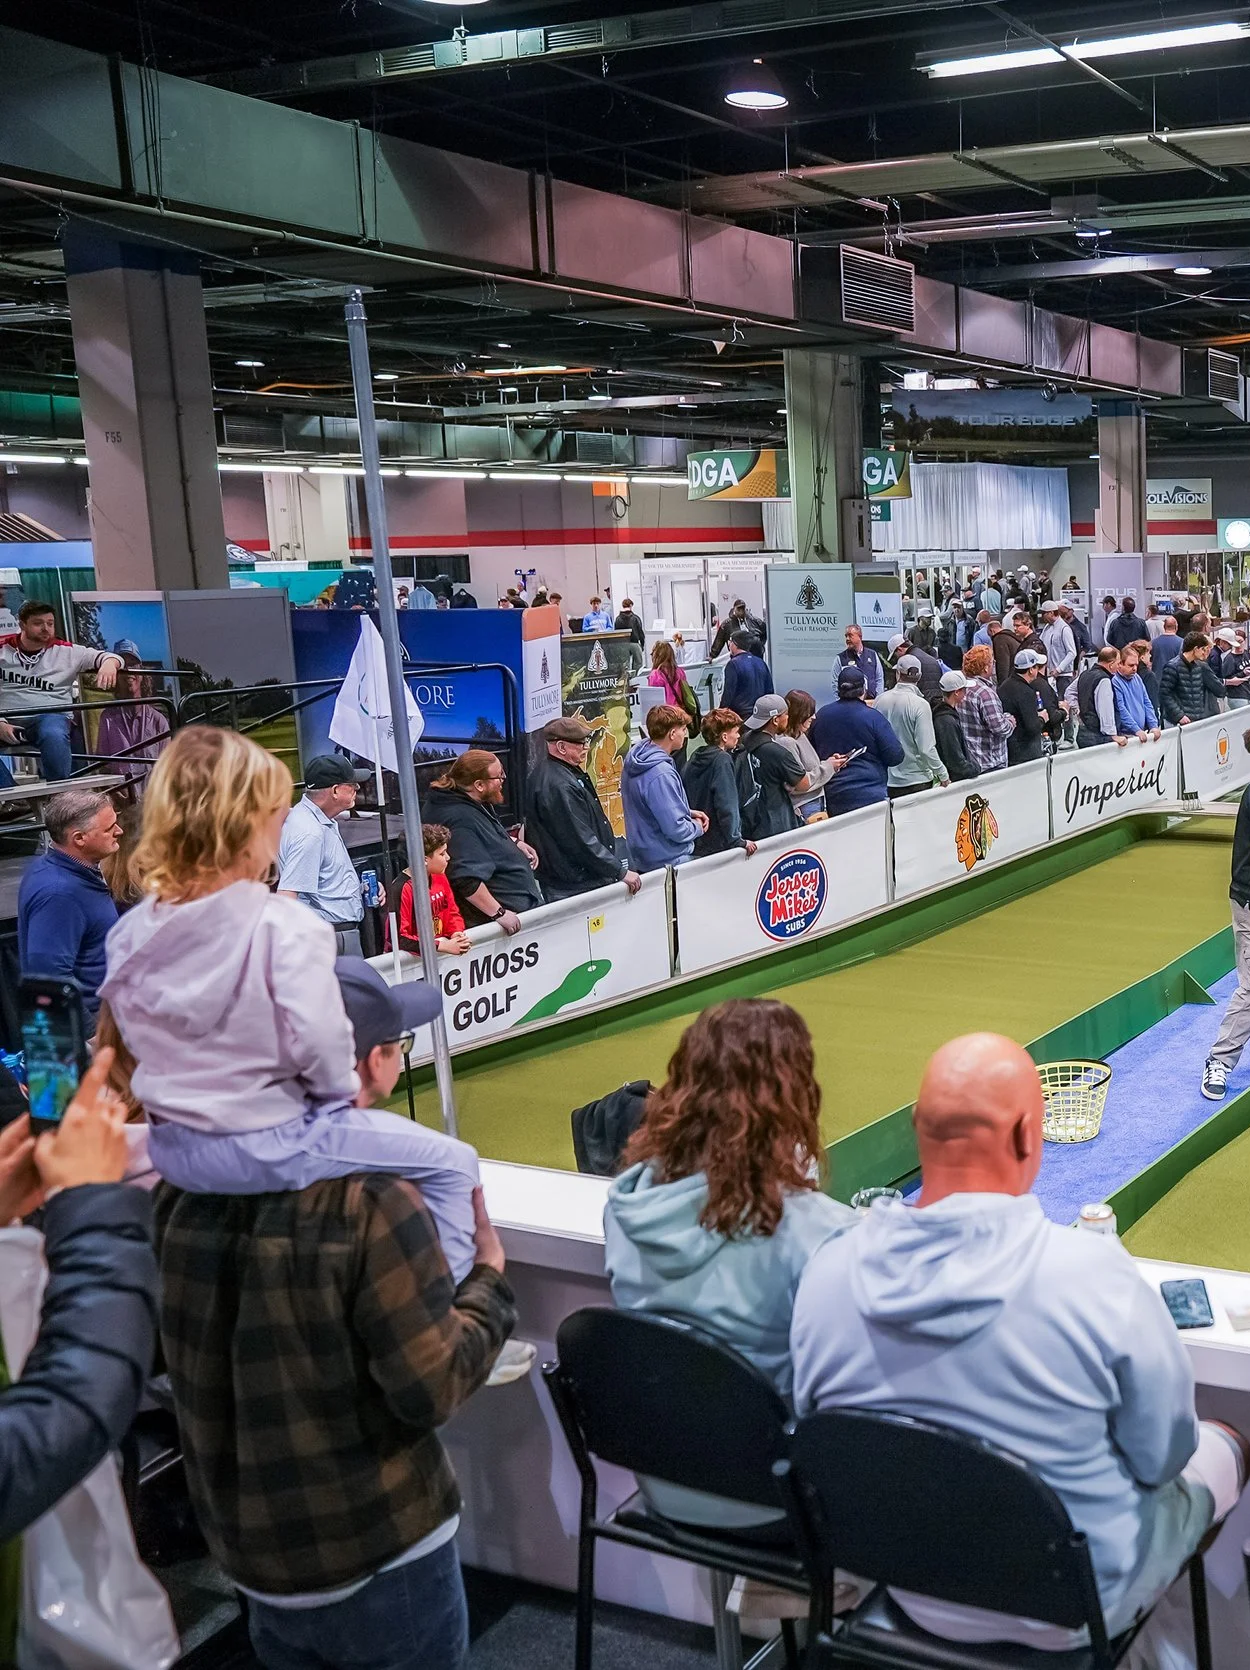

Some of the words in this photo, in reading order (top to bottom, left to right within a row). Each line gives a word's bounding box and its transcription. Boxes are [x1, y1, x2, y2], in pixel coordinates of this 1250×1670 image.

[955, 415, 1015, 426] TOUR
[1016, 415, 1077, 426] EDGE
[105, 431, 122, 443] F55
[1094, 588, 1137, 597] TOUR
[784, 616, 838, 627] TULLYMORE
[861, 616, 896, 625] TULLYMORE
[580, 677, 619, 691] TULLYMORE
[532, 689, 560, 712] TULLYMORE
[1065, 754, 1166, 824] Imperial
[780, 860, 794, 871] SINCE
[766, 868, 819, 902] Jersey
[770, 888, 819, 927] Mike's
[785, 918, 806, 934] SUBS
[470, 942, 539, 989] MOSS
[453, 985, 518, 1032] GOLF
